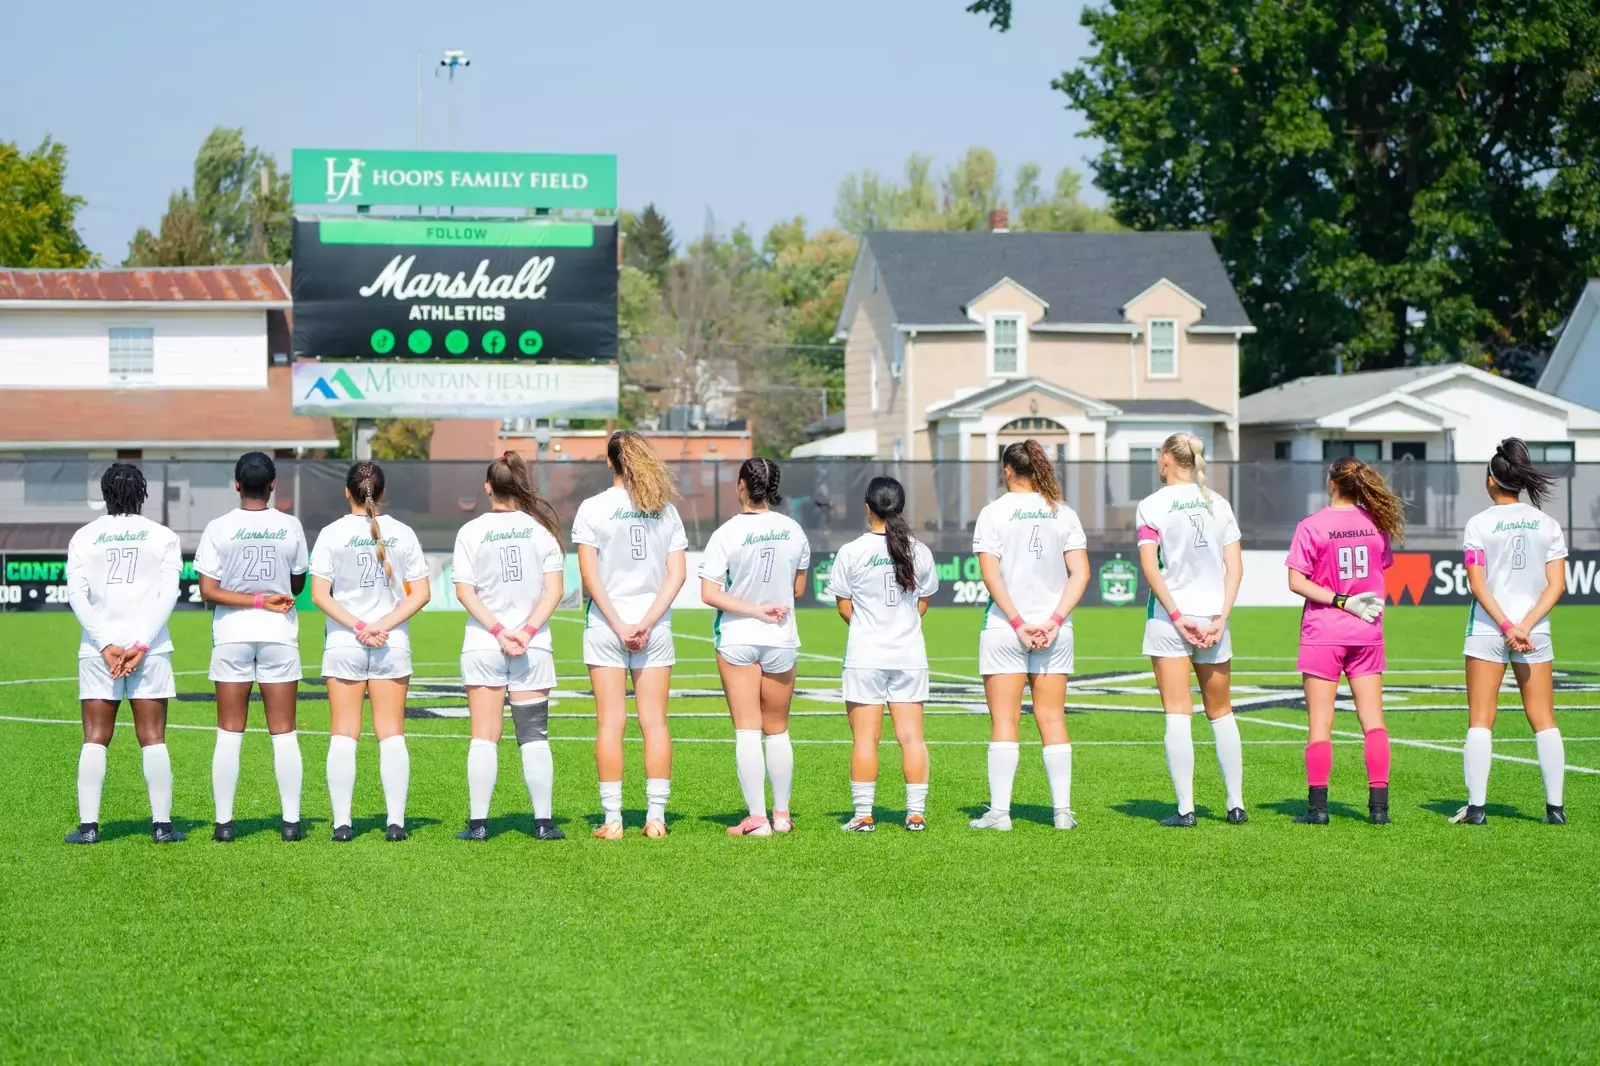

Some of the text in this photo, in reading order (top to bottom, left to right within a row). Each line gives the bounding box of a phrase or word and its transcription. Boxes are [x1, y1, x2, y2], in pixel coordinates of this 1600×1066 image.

[372, 169, 588, 190] HOOPS FAMILY FIELD
[426, 227, 488, 240] FOLLOW
[359, 254, 555, 300] Marshall
[409, 305, 506, 321] ATHLETICS
[365, 367, 480, 393] MOUNTAIN
[487, 372, 560, 391] HEALTH
[93, 530, 149, 544] Marshall
[230, 528, 288, 541] Marshall
[480, 528, 533, 544] Marshall
[630, 524, 647, 560] 9
[741, 529, 791, 546] Marshall
[1028, 524, 1043, 559] 4
[1189, 513, 1208, 548] 2
[1328, 529, 1376, 539] MARSHALL
[1492, 517, 1540, 534] Marshall
[106, 548, 138, 585] 27
[243, 545, 276, 581] 25
[500, 545, 523, 582] 19
[760, 547, 775, 583] 7
[1337, 545, 1369, 580] 99
[1511, 535, 1526, 570] 8
[884, 571, 900, 607] 6
[1434, 560, 1473, 595] St
